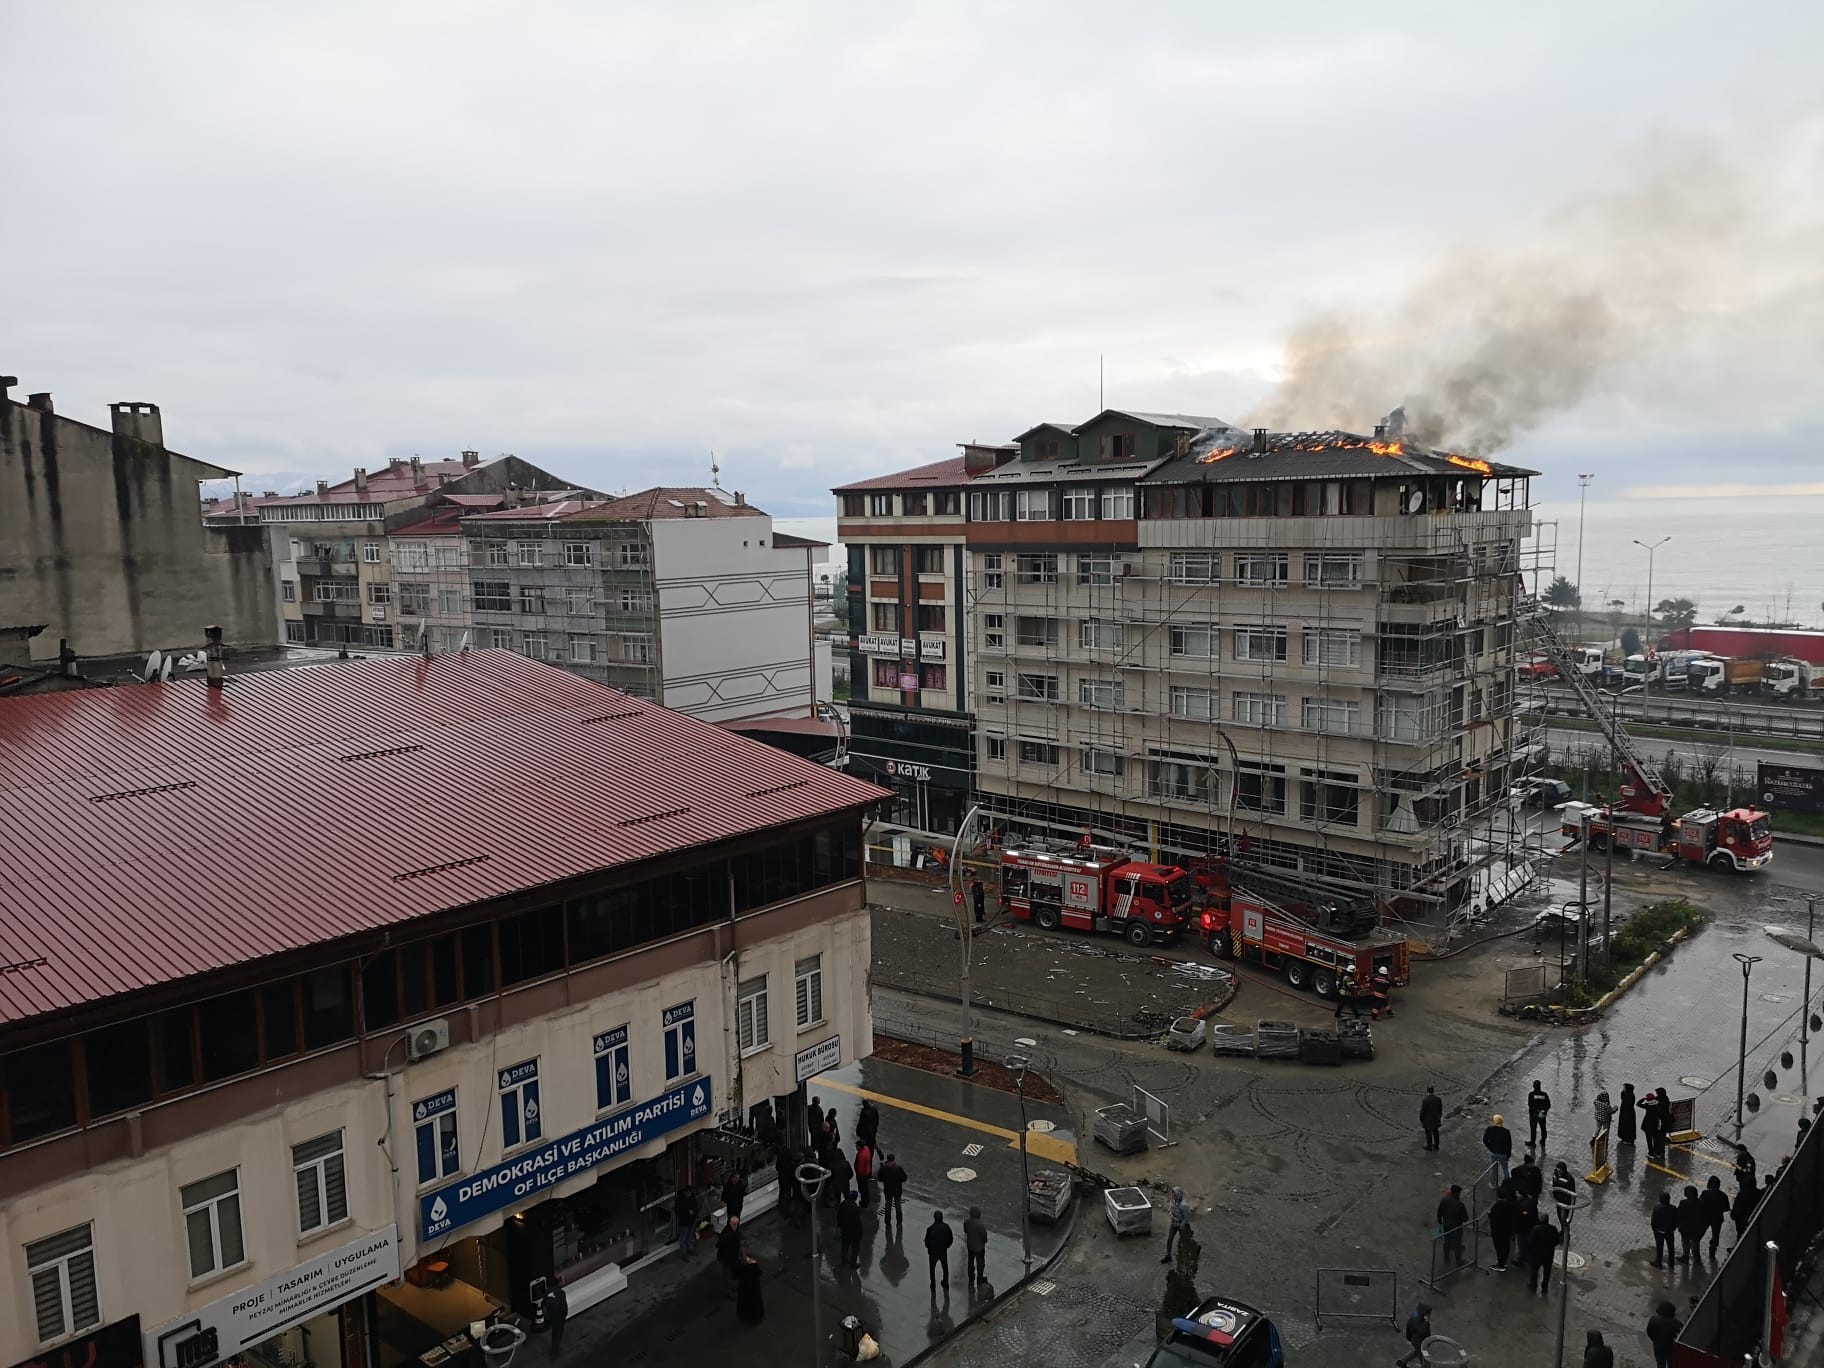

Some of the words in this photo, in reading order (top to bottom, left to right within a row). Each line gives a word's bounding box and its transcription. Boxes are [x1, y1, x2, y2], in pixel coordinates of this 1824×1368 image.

[860, 636, 877, 645] AVUKAT
[880, 638, 898, 646] AVUKAT
[923, 641, 941, 649] AVUKAT
[1071, 883, 1085, 894] 112
[673, 1005, 692, 1018] DEVA
[604, 1030, 626, 1044] DEVA
[798, 1050, 817, 1064] HUKUK
[512, 1063, 536, 1078] DEVA
[427, 1094, 453, 1110] DEVA
[690, 1104, 708, 1117] DEVA
[458, 1145, 558, 1203] DEMOKRASİ
[561, 1137, 582, 1159] VE
[584, 1115, 632, 1149] ATILIM
[635, 1090, 686, 1126] PARTİSİ
[514, 1181, 534, 1197] OF
[536, 1166, 565, 1190] İLÇE
[567, 1130, 643, 1178] BAŞKANLIĞI
[428, 1218, 451, 1234] DEVA
[231, 1293, 266, 1316] PROJE
[277, 1268, 323, 1295] TASARIM
[334, 1239, 389, 1269] UYGULAMA
[249, 1304, 274, 1320] PEYZAJ
[1217, 1302, 1250, 1316] ZABITA
